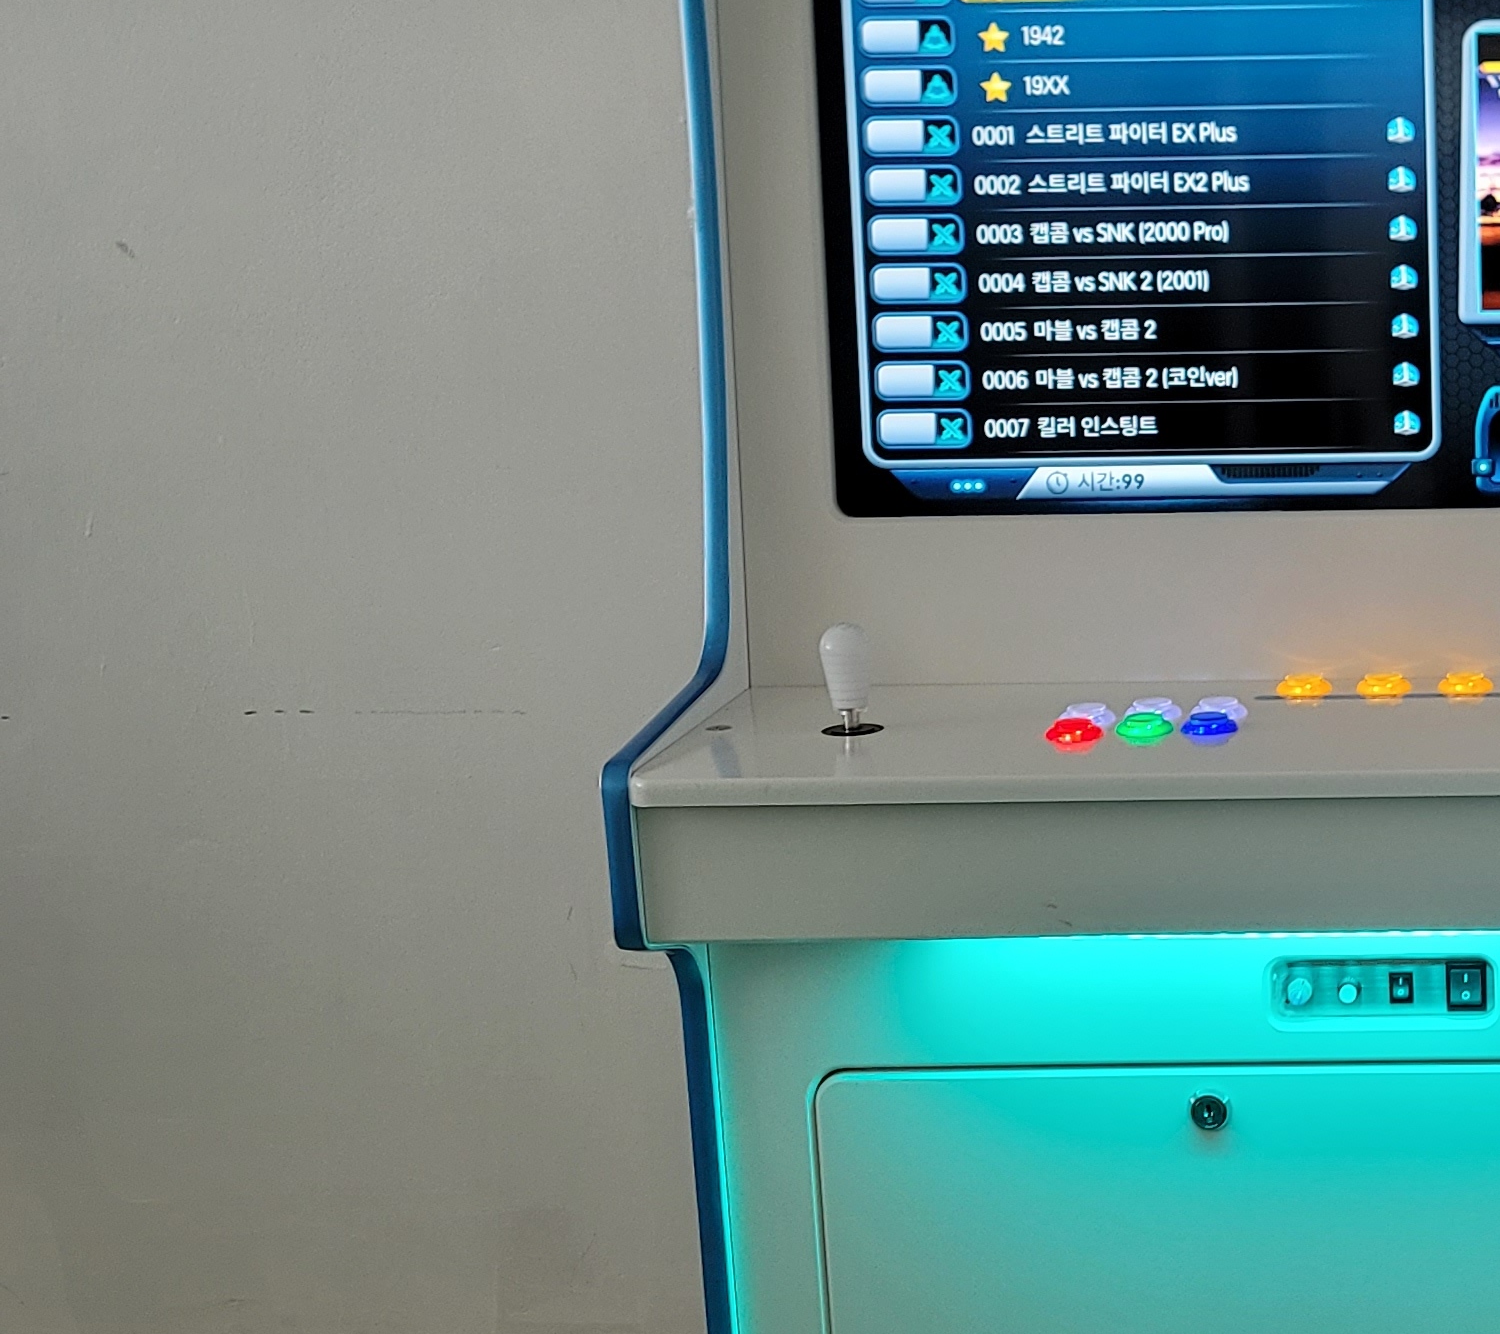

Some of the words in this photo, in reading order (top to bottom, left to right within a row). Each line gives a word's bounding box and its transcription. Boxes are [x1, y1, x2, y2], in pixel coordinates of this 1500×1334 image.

[1021, 25, 1065, 48] 1942
[1023, 74, 1070, 97] 19XX
[972, 125, 1015, 147] 0001
[1025, 121, 1104, 147] 스트리트
[1109, 119, 1167, 147] 파이터
[1172, 121, 1196, 145] EX
[1198, 120, 1238, 144] Plus
[974, 174, 1021, 196] 0002
[1027, 170, 1105, 196] 스트리트
[1110, 168, 1169, 196] 파이터
[1173, 170, 1208, 194] EX2
[1211, 169, 1250, 193] Plus
[976, 224, 1023, 245] 0003
[1029, 219, 1069, 246] 캡콤
[1073, 225, 1094, 244] vs
[1097, 220, 1135, 244] SNK
[1139, 217, 1188, 246] (2000
[1193, 216, 1230, 244] Pro)
[978, 273, 1025, 294] 0004
[1031, 268, 1070, 295] 캡콤
[1075, 274, 1095, 293] vs
[1098, 270, 1136, 293] SNK
[1140, 270, 1153, 292] 2
[1157, 266, 1210, 295] (2001)
[980, 321, 1027, 343] 0005
[1034, 317, 1072, 343] 마블
[1077, 323, 1097, 341] vs
[1101, 315, 1140, 343] 캡콤
[1144, 319, 1157, 341] 2
[982, 370, 1029, 391] 0006
[1035, 366, 1074, 392] 마블
[1079, 371, 1099, 390] vs
[1102, 364, 1142, 391] 캡콤
[1146, 367, 1159, 389] 2
[1162, 362, 1239, 391] (코인ver)
[984, 418, 1030, 439] 0007
[1037, 413, 1077, 440] 킬러
[1081, 412, 1159, 439] 인스팅트
[1077, 471, 1145, 494] 시간:99
